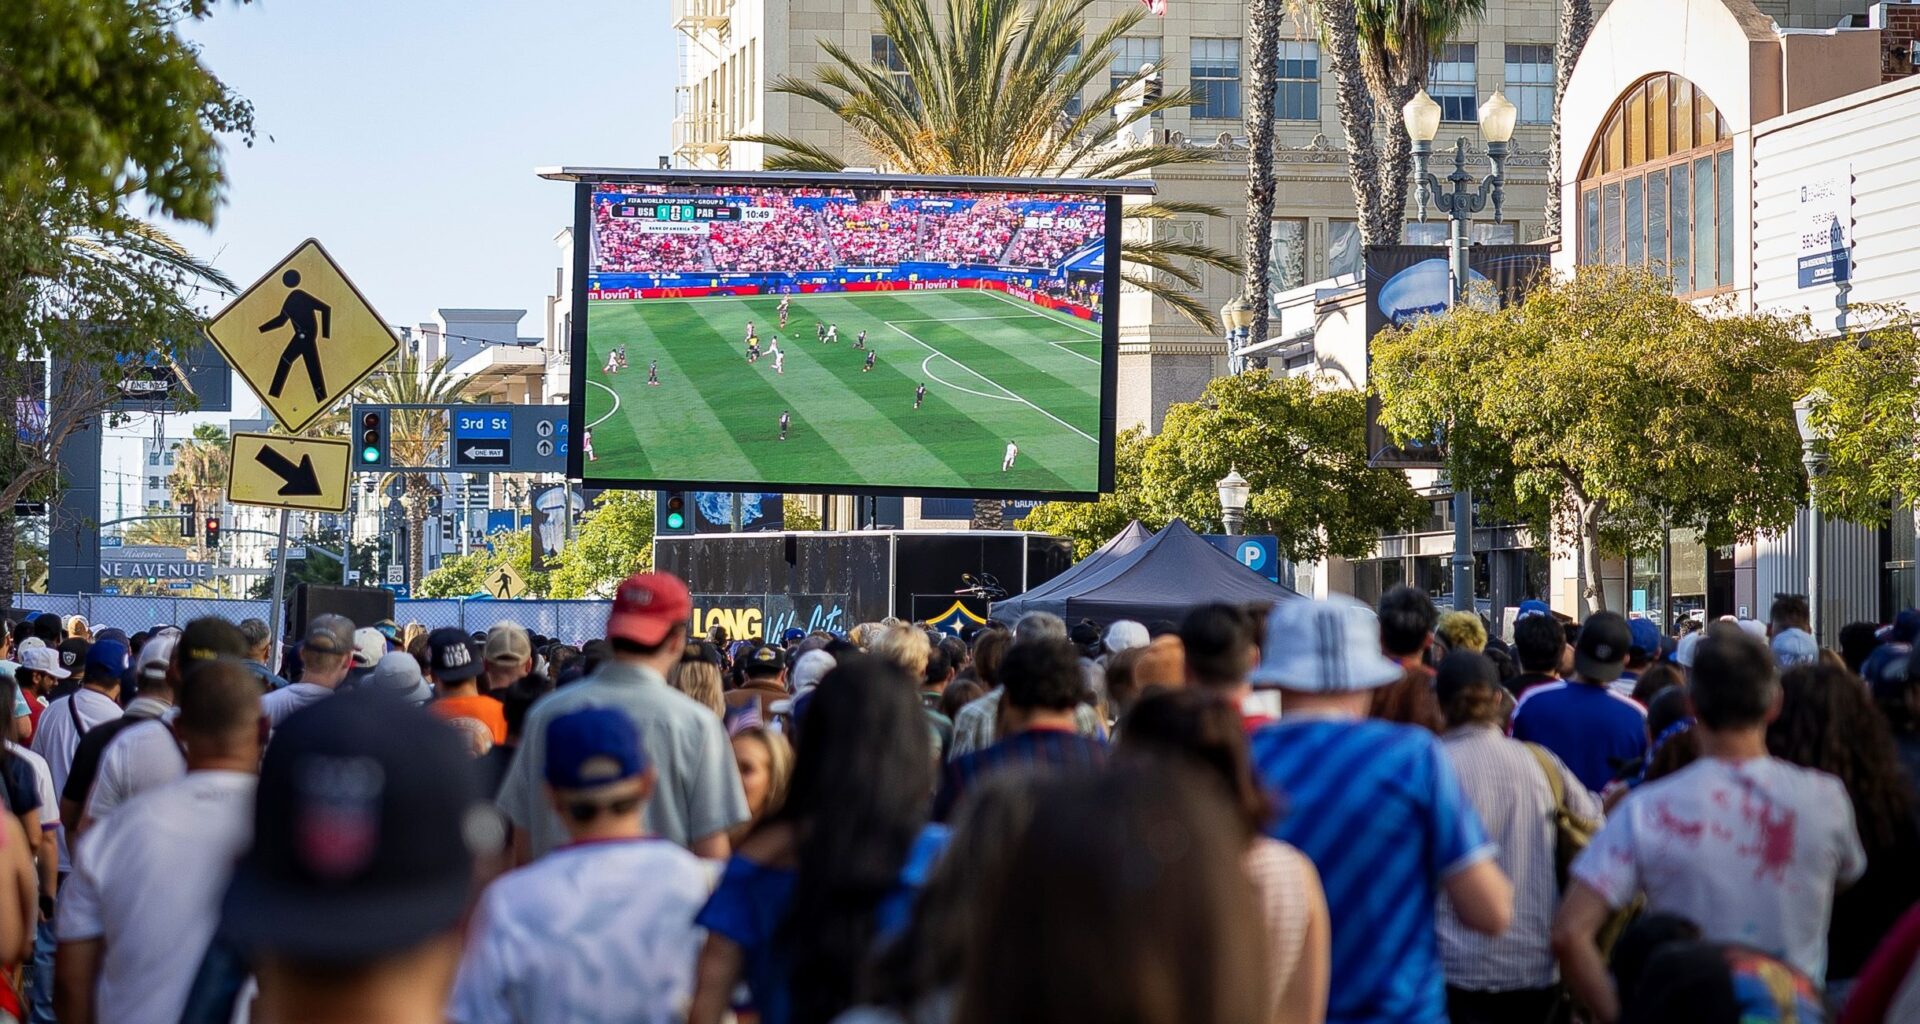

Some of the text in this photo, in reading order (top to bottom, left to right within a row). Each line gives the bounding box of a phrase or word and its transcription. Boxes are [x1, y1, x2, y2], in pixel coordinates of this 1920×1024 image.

[638, 208, 770, 219] USA 1 0 PAR 10:49
[1057, 217, 1082, 230] FOX
[909, 279, 959, 290] i'm lovin' it
[600, 289, 632, 300] lovin'
[634, 288, 643, 299] it
[461, 418, 507, 430] 3rd St
[475, 449, 502, 457] ONE WAY
[1245, 546, 1260, 567] P
[131, 563, 206, 577] AVENUE
[389, 574, 402, 583] 20
[693, 608, 762, 640] LONG
[444, 648, 471, 667] USA
